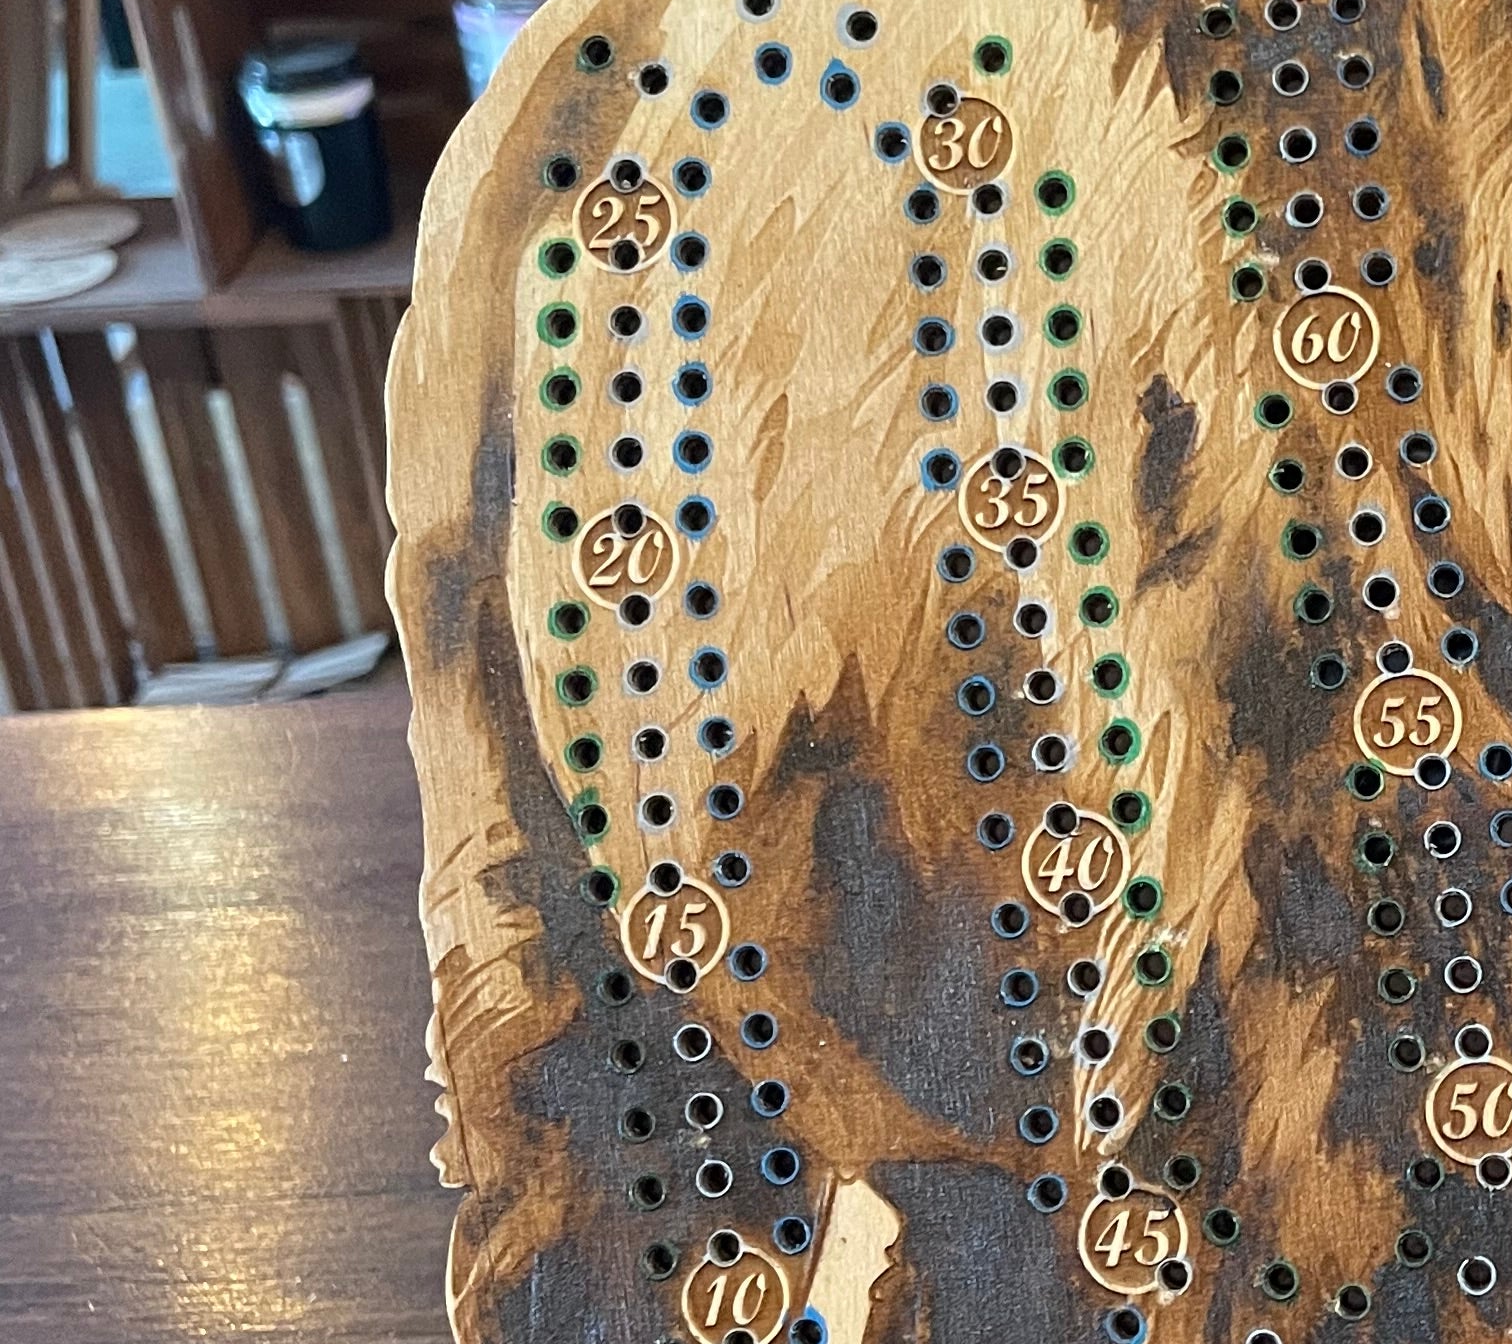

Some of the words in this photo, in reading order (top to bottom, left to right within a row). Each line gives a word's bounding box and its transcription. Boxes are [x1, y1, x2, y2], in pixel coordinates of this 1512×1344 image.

[929, 116, 1002, 170] 30
[589, 195, 661, 249] 25
[1292, 312, 1361, 364] 60
[975, 474, 1048, 528] 35
[588, 531, 663, 586] 20
[1373, 696, 1441, 747] 55
[1038, 836, 1113, 892] 40
[643, 903, 706, 958] 15
[1095, 1210, 1170, 1267] 45
[705, 1273, 765, 1327] 10
